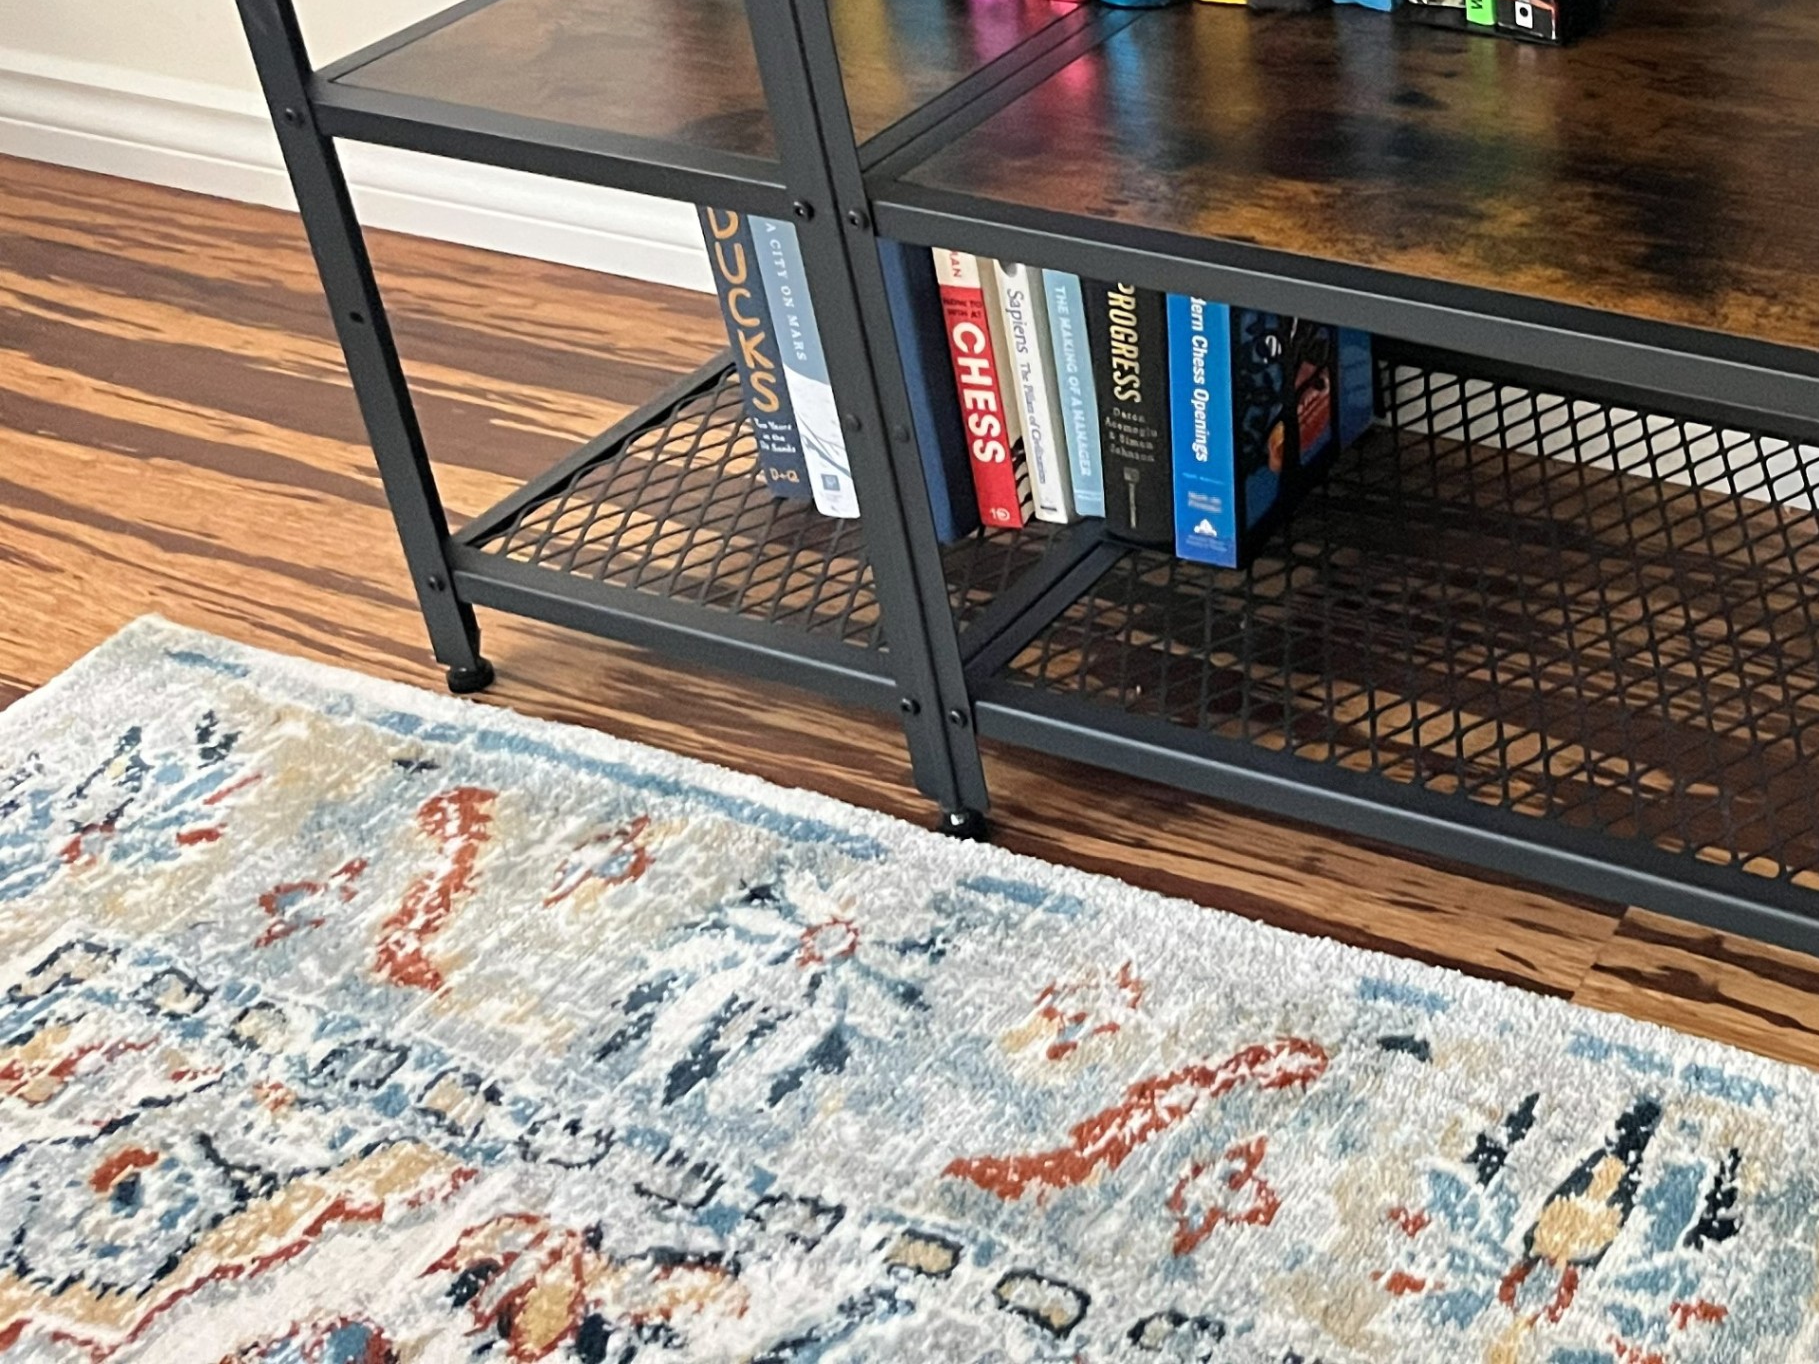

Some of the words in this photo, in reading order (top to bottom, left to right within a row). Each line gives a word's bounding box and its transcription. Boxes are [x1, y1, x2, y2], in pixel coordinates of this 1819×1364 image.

[765, 222, 777, 233] A
[769, 238, 788, 279] CITY
[706, 206, 780, 413] DUCKS
[780, 285, 795, 308] ON
[1054, 285, 1070, 315] THE
[787, 313, 807, 361] MARS
[1005, 288, 1029, 354] Sapiens
[1020, 362, 1032, 382] The
[1060, 316, 1078, 374] MAKING
[1191, 335, 1208, 385] Chess
[952, 321, 1006, 463] CHESS
[1067, 376, 1081, 397] OF
[1071, 399, 1083, 409] A
[1072, 410, 1092, 477] MANAGER
[1191, 388, 1210, 462] Openings
